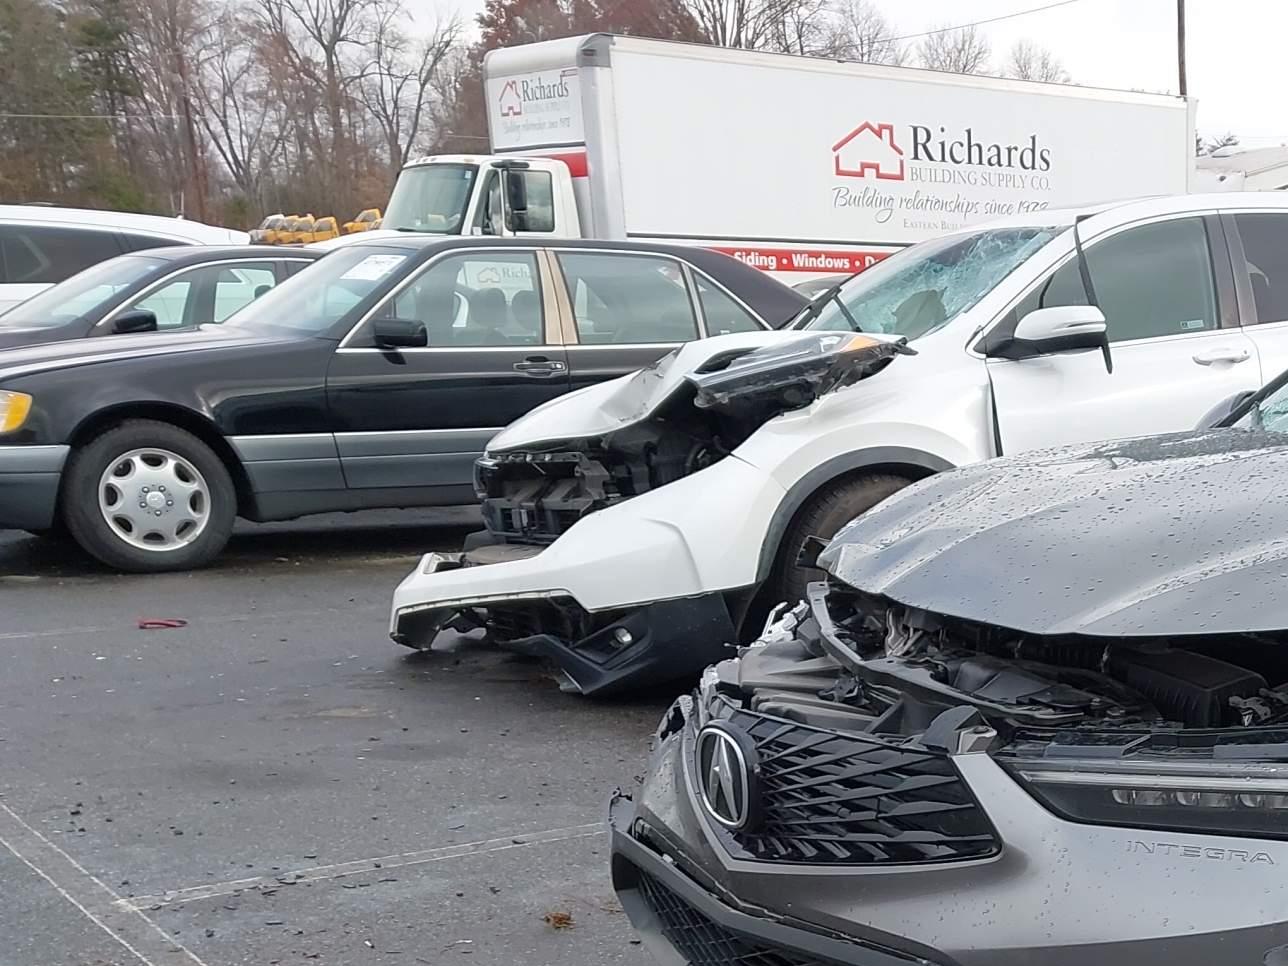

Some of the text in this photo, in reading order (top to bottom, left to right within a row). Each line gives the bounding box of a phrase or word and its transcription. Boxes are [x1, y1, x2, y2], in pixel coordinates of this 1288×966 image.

[521, 76, 569, 102] Richards
[908, 124, 1051, 172] Richards
[909, 166, 1052, 191] BUILDING SUPPLY CO.
[831, 186, 895, 224] Building
[899, 189, 980, 220] relationships
[984, 199, 1014, 215] since
[734, 251, 777, 270] Siding
[791, 253, 850, 269] Windows
[1126, 839, 1275, 865] INTEGRA
